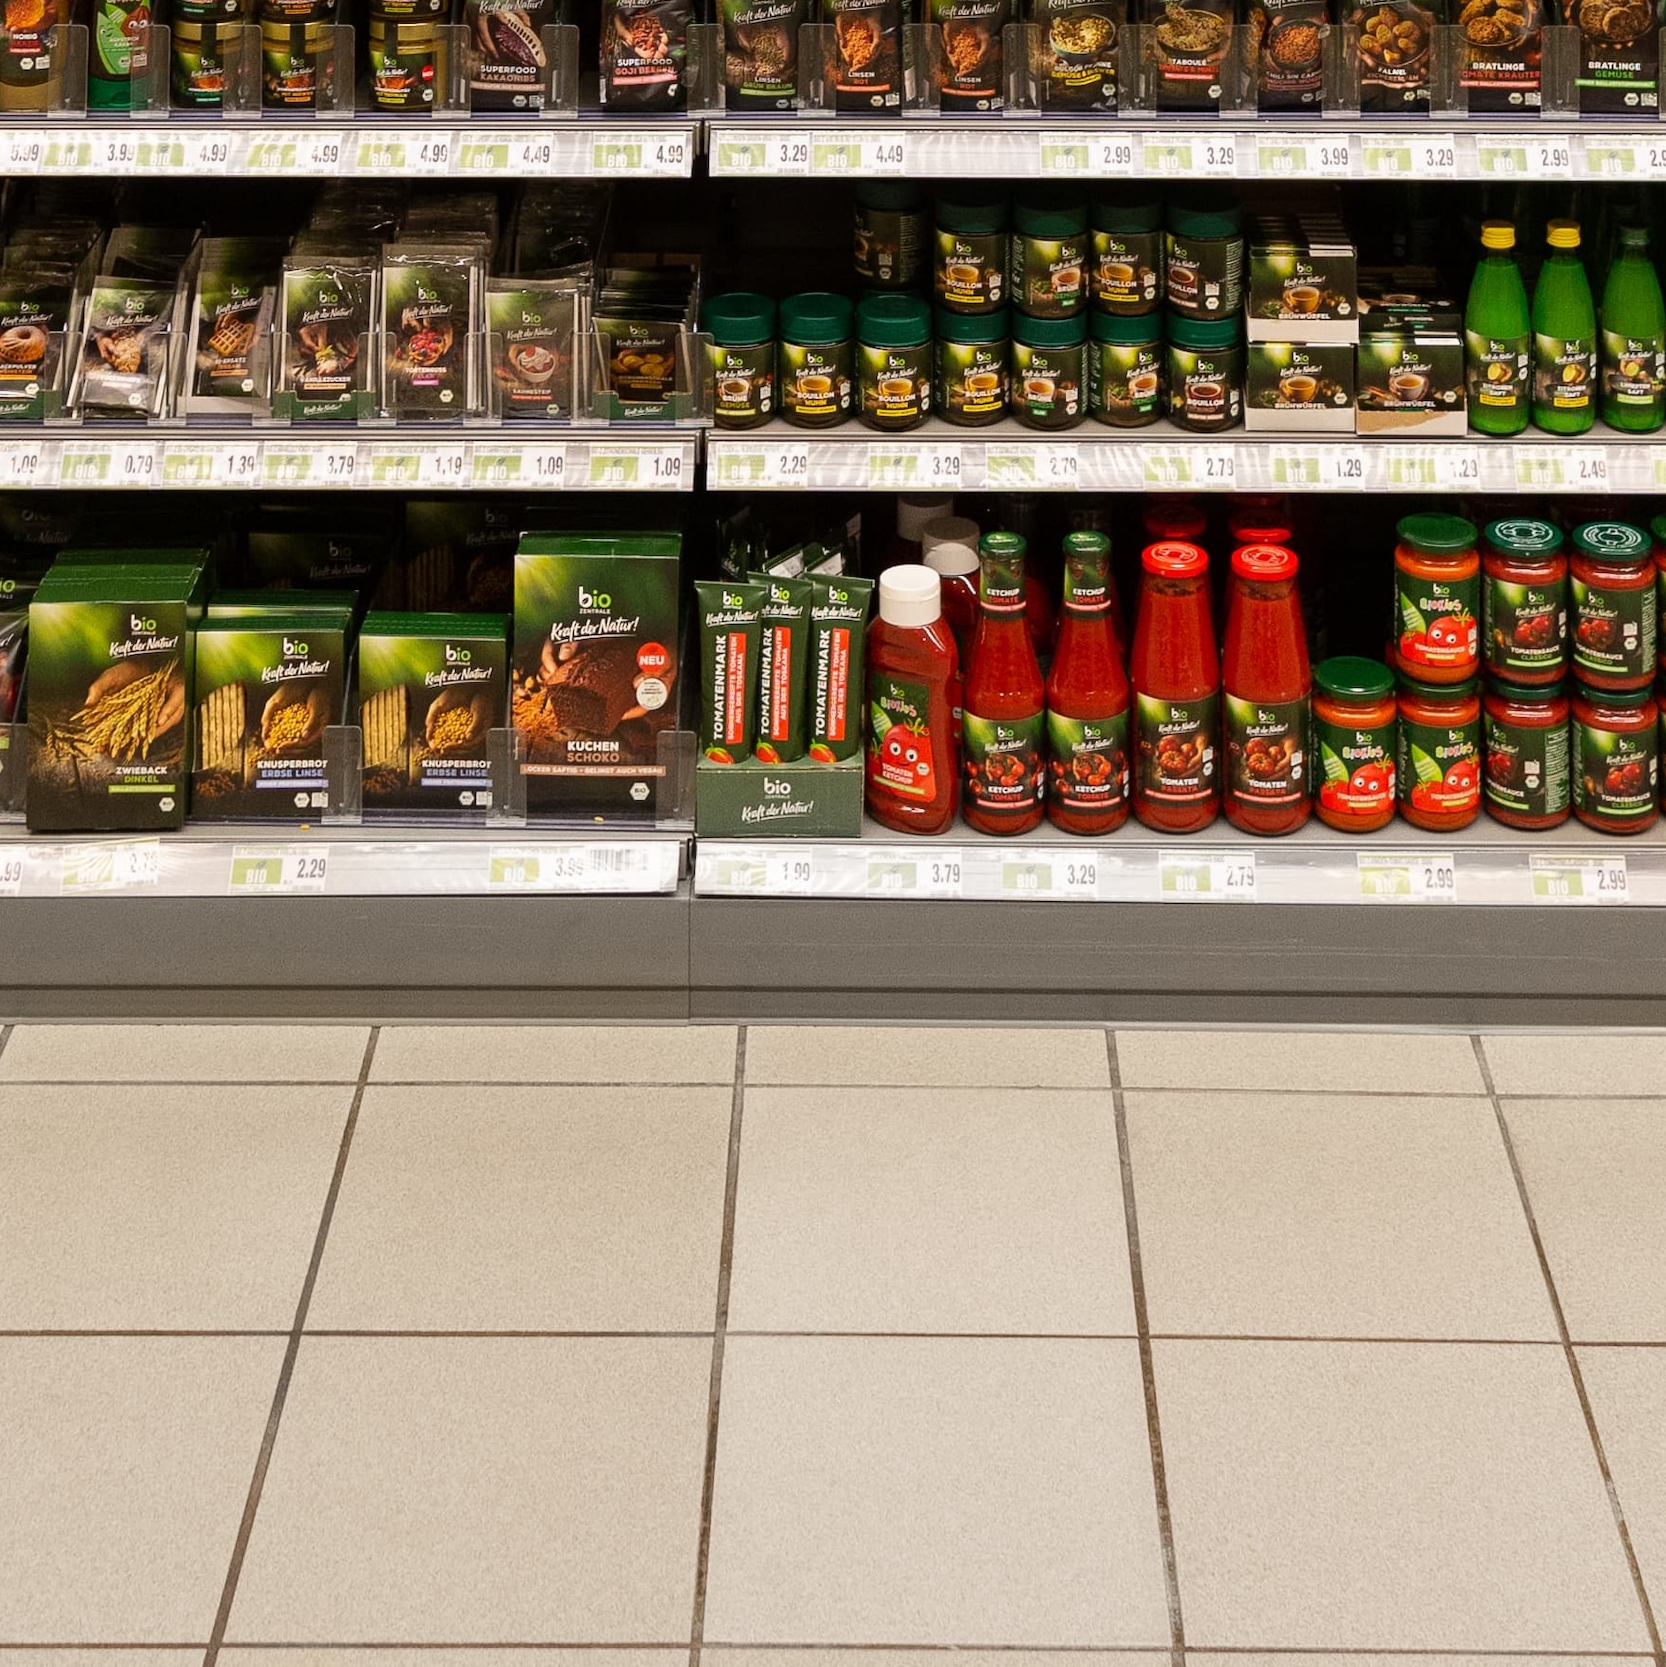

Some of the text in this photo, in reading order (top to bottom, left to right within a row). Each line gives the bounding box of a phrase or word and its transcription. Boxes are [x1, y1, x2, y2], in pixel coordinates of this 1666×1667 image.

[480, 64, 536, 74] SUPERFOOD
[1589, 62, 1641, 71] BRATLINGE
[1103, 146, 1130, 163] 2.99
[536, 456, 563, 476] 1.09
[1579, 461, 1606, 479] 2.49
[579, 586, 612, 607] bio
[550, 623, 579, 641] Kraft
[602, 616, 638, 633] Natur!
[639, 654, 664, 664] NEU
[729, 636, 738, 674] TOMATEN
[712, 634, 725, 741] TOMATENMARK
[567, 741, 619, 752] KUCHEN
[257, 760, 328, 769] KNUSPERBROT
[567, 752, 619, 763] SCHOKO
[116, 766, 167, 775] ZWIEBACK
[763, 777, 792, 796] bio
[988, 785, 1023, 794] KETCHUP
[932, 865, 960, 883] 3.79
